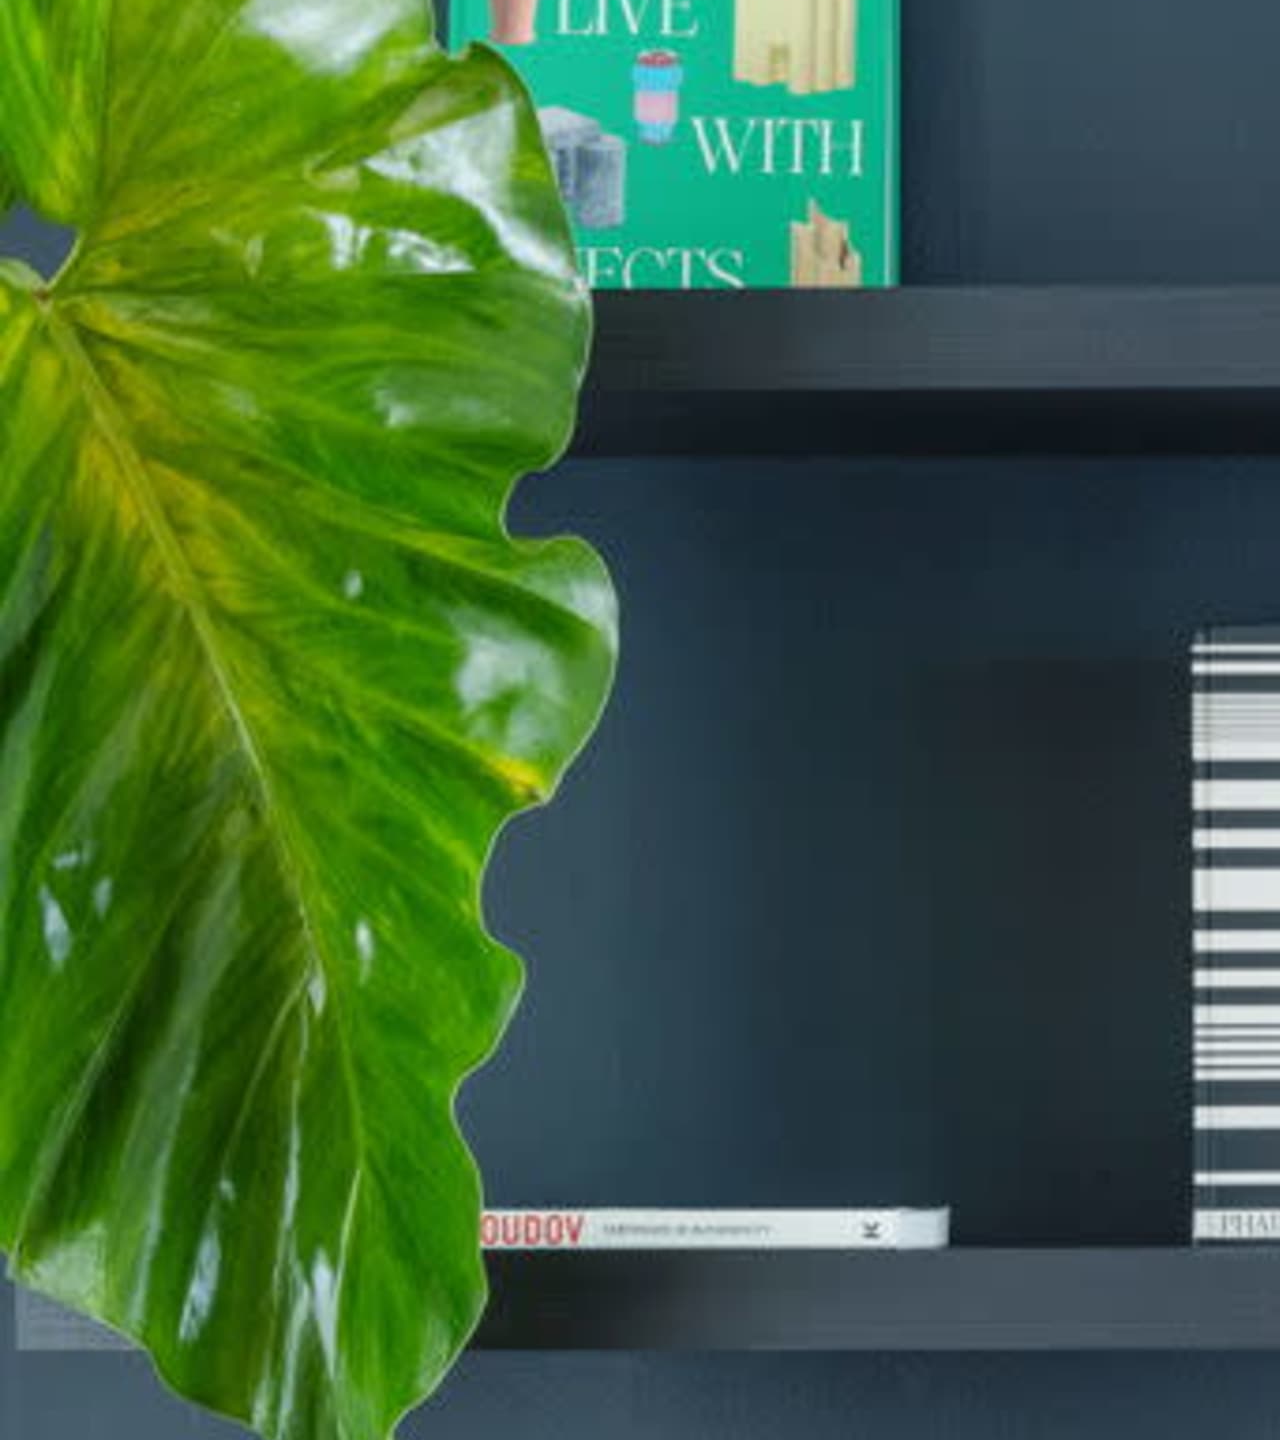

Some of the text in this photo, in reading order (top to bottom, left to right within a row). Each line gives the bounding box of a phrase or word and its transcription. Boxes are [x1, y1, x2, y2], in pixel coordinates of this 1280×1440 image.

[691, 117, 863, 177] WITH
[577, 246, 744, 288] ECTS
[482, 1214, 585, 1246] OUDOV
